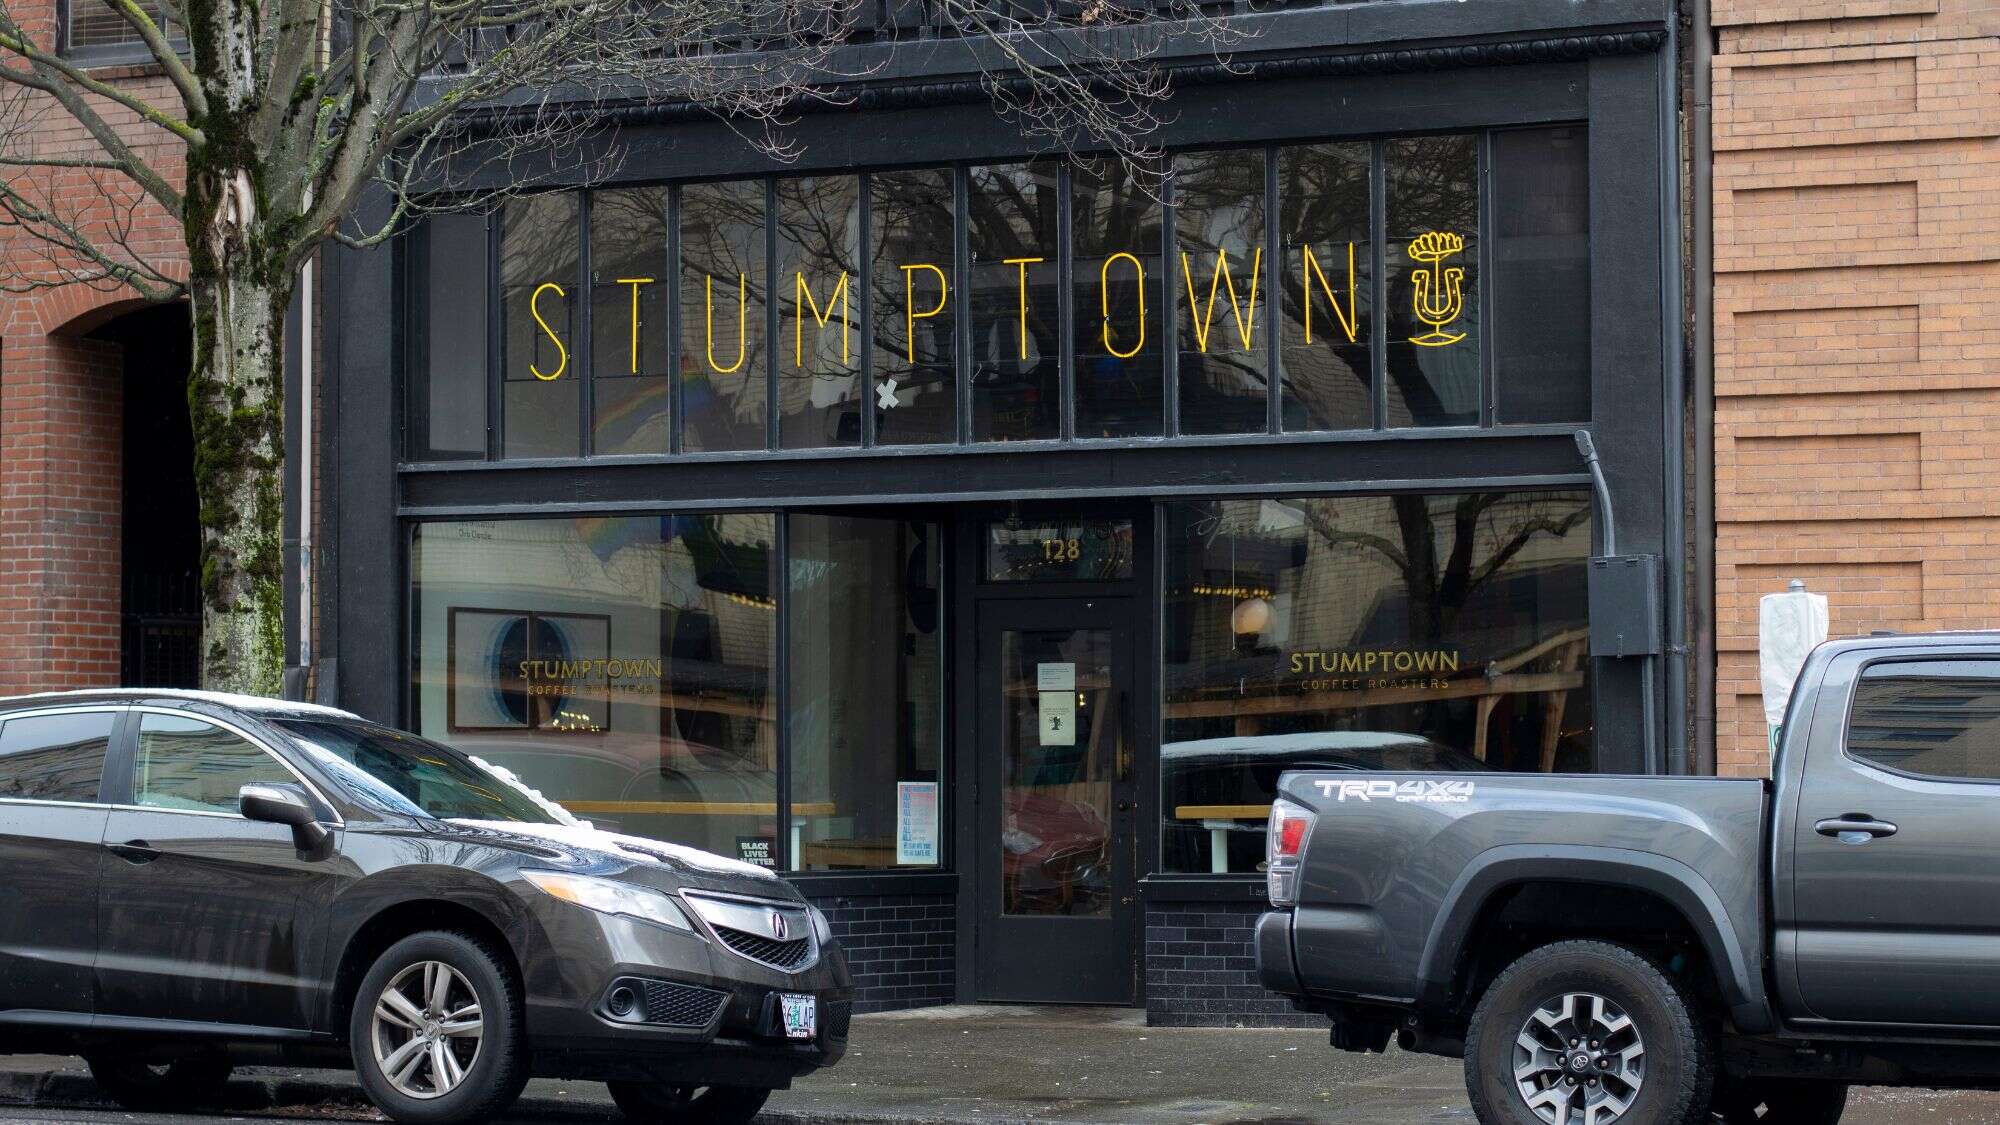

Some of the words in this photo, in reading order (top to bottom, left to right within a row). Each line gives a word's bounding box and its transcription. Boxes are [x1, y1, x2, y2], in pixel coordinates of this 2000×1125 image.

[529, 241, 1356, 381] STUMPTOWN
[1043, 539, 1080, 560] 128
[519, 658, 663, 679] STUMPTOWN
[1289, 650, 1459, 673] STUMPTOWN
[528, 684, 577, 696] COFFEE
[1301, 679, 1360, 690] COFFEE
[1368, 678, 1449, 690] ROASTERS
[1313, 779, 1397, 803] TRD
[741, 842, 769, 850] BLACK
[743, 850, 768, 858] LIVES
